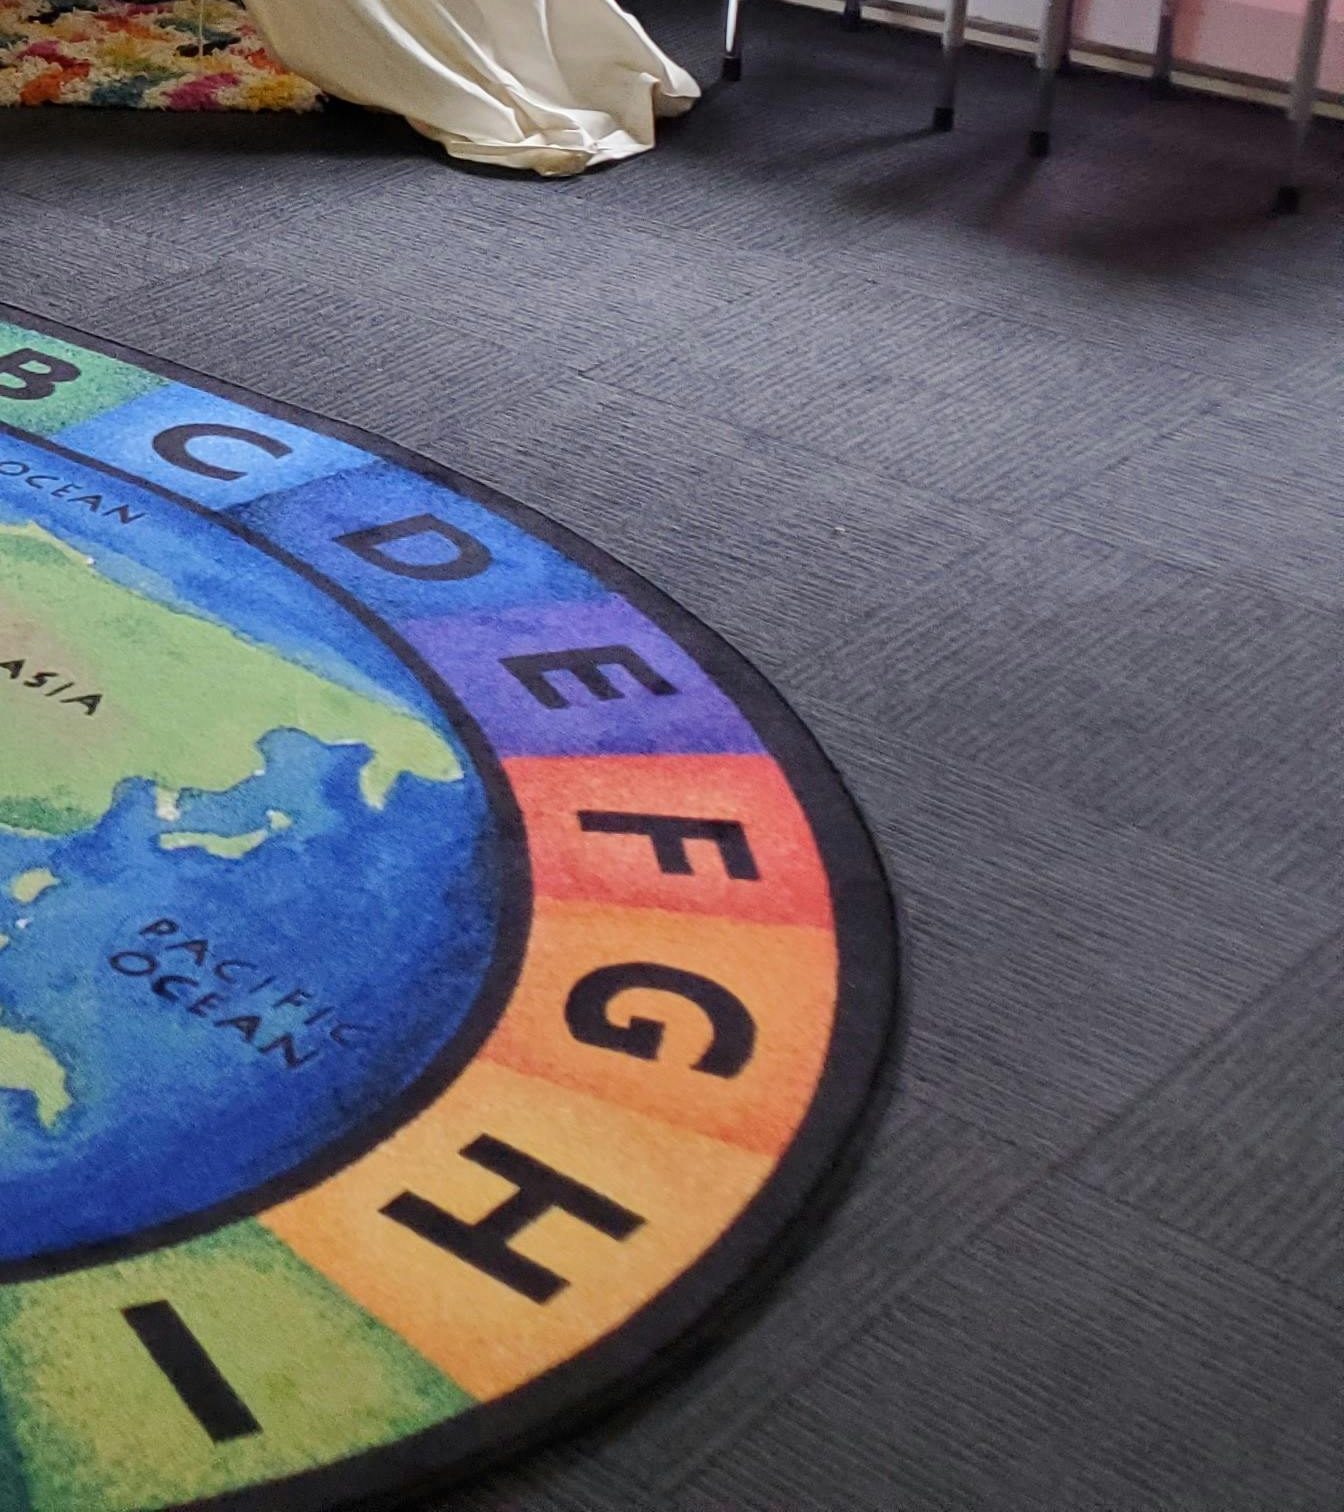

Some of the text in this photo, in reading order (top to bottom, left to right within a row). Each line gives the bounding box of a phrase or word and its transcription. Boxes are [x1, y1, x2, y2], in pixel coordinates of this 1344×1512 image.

[151, 423, 294, 482] C
[332, 513, 493, 581] D
[499, 644, 681, 710] E
[577, 810, 761, 882] F
[110, 950, 320, 1070] OCEAN
[137, 918, 374, 1046] PACIFIC
[563, 961, 758, 1079] G
[377, 1133, 647, 1306] H
[119, 1299, 264, 1443] I
